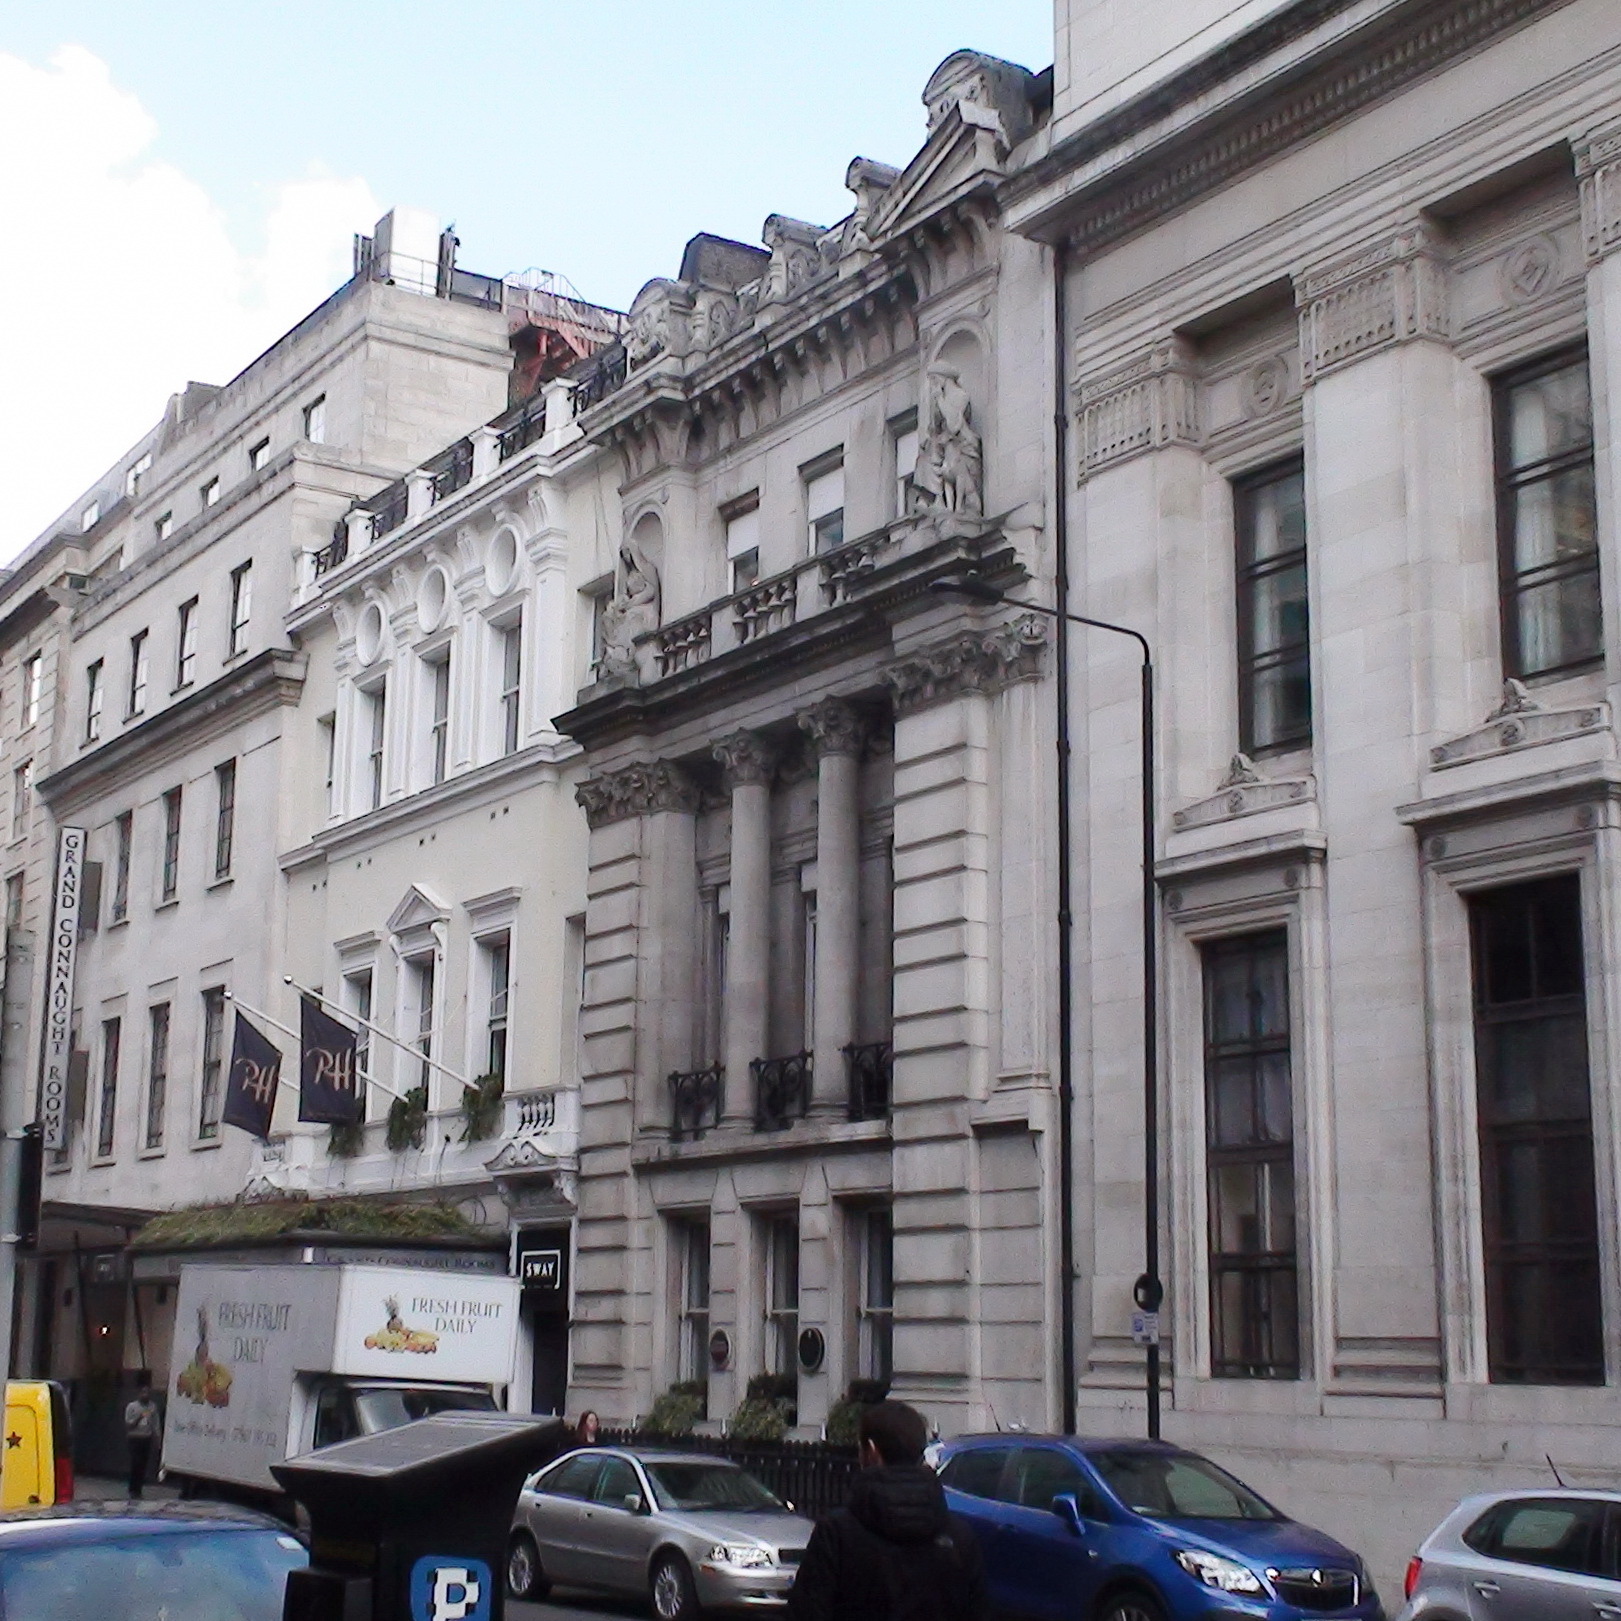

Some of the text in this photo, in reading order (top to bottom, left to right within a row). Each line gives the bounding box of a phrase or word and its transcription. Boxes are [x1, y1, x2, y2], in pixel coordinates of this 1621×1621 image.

[46, 835, 78, 1142] GRAND CONNAUGHT ROOMS
[526, 1261, 555, 1278] SWAY
[411, 1297, 503, 1319] FRESH FRUIT
[435, 1317, 477, 1334] DAILY
[233, 1336, 268, 1364] DAILY
[432, 1567, 480, 1621] P
